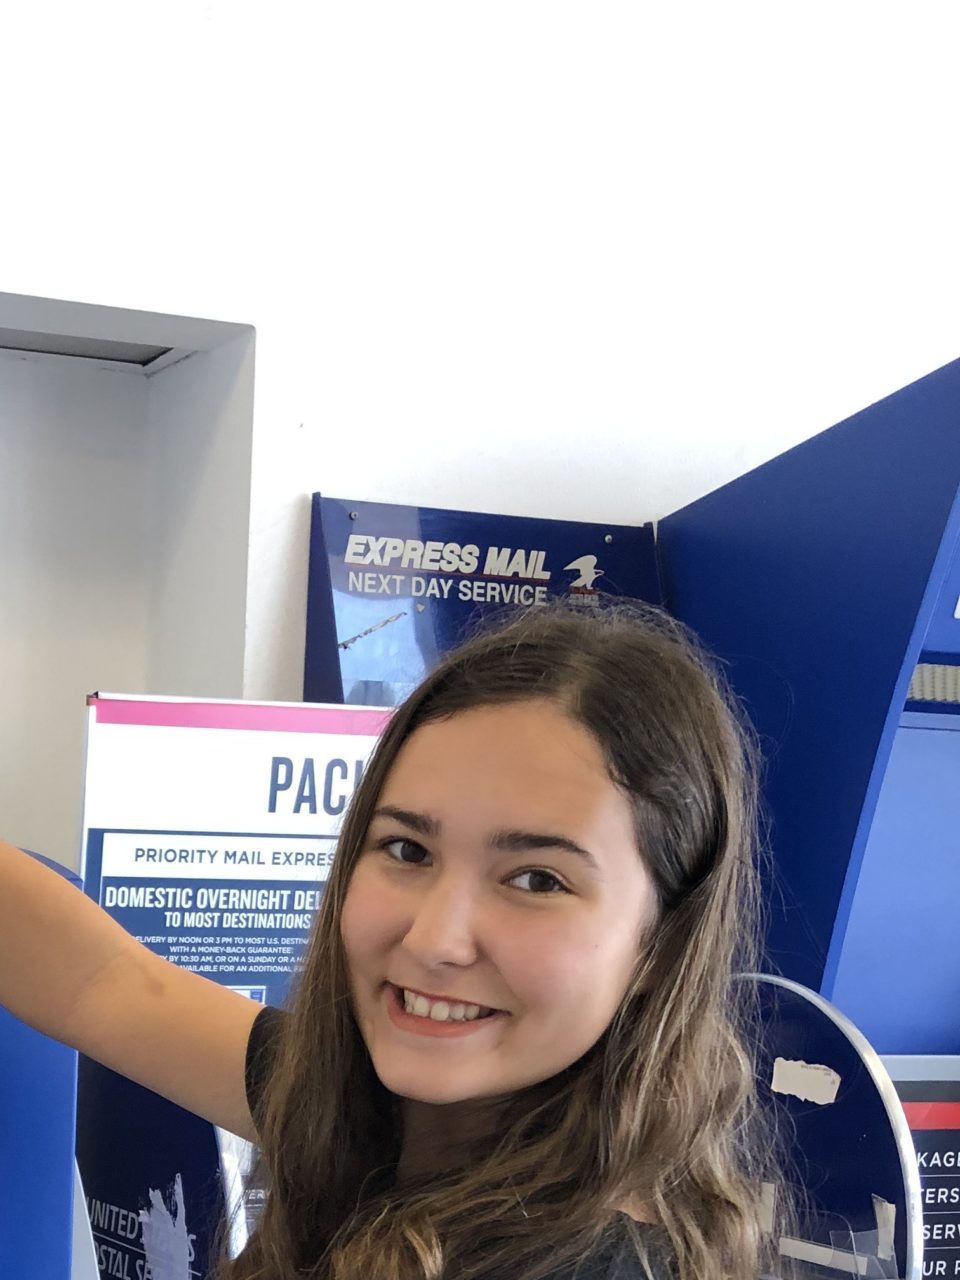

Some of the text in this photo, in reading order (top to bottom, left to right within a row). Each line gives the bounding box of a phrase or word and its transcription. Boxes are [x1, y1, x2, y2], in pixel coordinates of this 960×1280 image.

[344, 534, 552, 579] EXPRESS MAIL
[348, 572, 406, 596] NEXT
[411, 576, 454, 600] DAY
[458, 580, 548, 606] SERVICE
[135, 847, 218, 864] PRIORITY
[224, 850, 266, 866] MAIL
[105, 886, 292, 910] DOMESTIC OVERNIGHT
[164, 911, 312, 930] TO MOST DESTINATIONS
[167, 936, 280, 946] BY NOON OR 3 PM TO MOST U.S.
[169, 945, 189, 953] WITH
[198, 946, 246, 954] MONEY-BACK
[169, 955, 179, 963] BY
[181, 955, 199, 963] 10:30
[227, 956, 240, 964] ON
[247, 956, 277, 964] SUNDAY
[278, 956, 289, 964] OR
[219, 965, 234, 973] FOR
[236, 965, 247, 973] AN
[248, 965, 292, 973] ADDITIONAL
